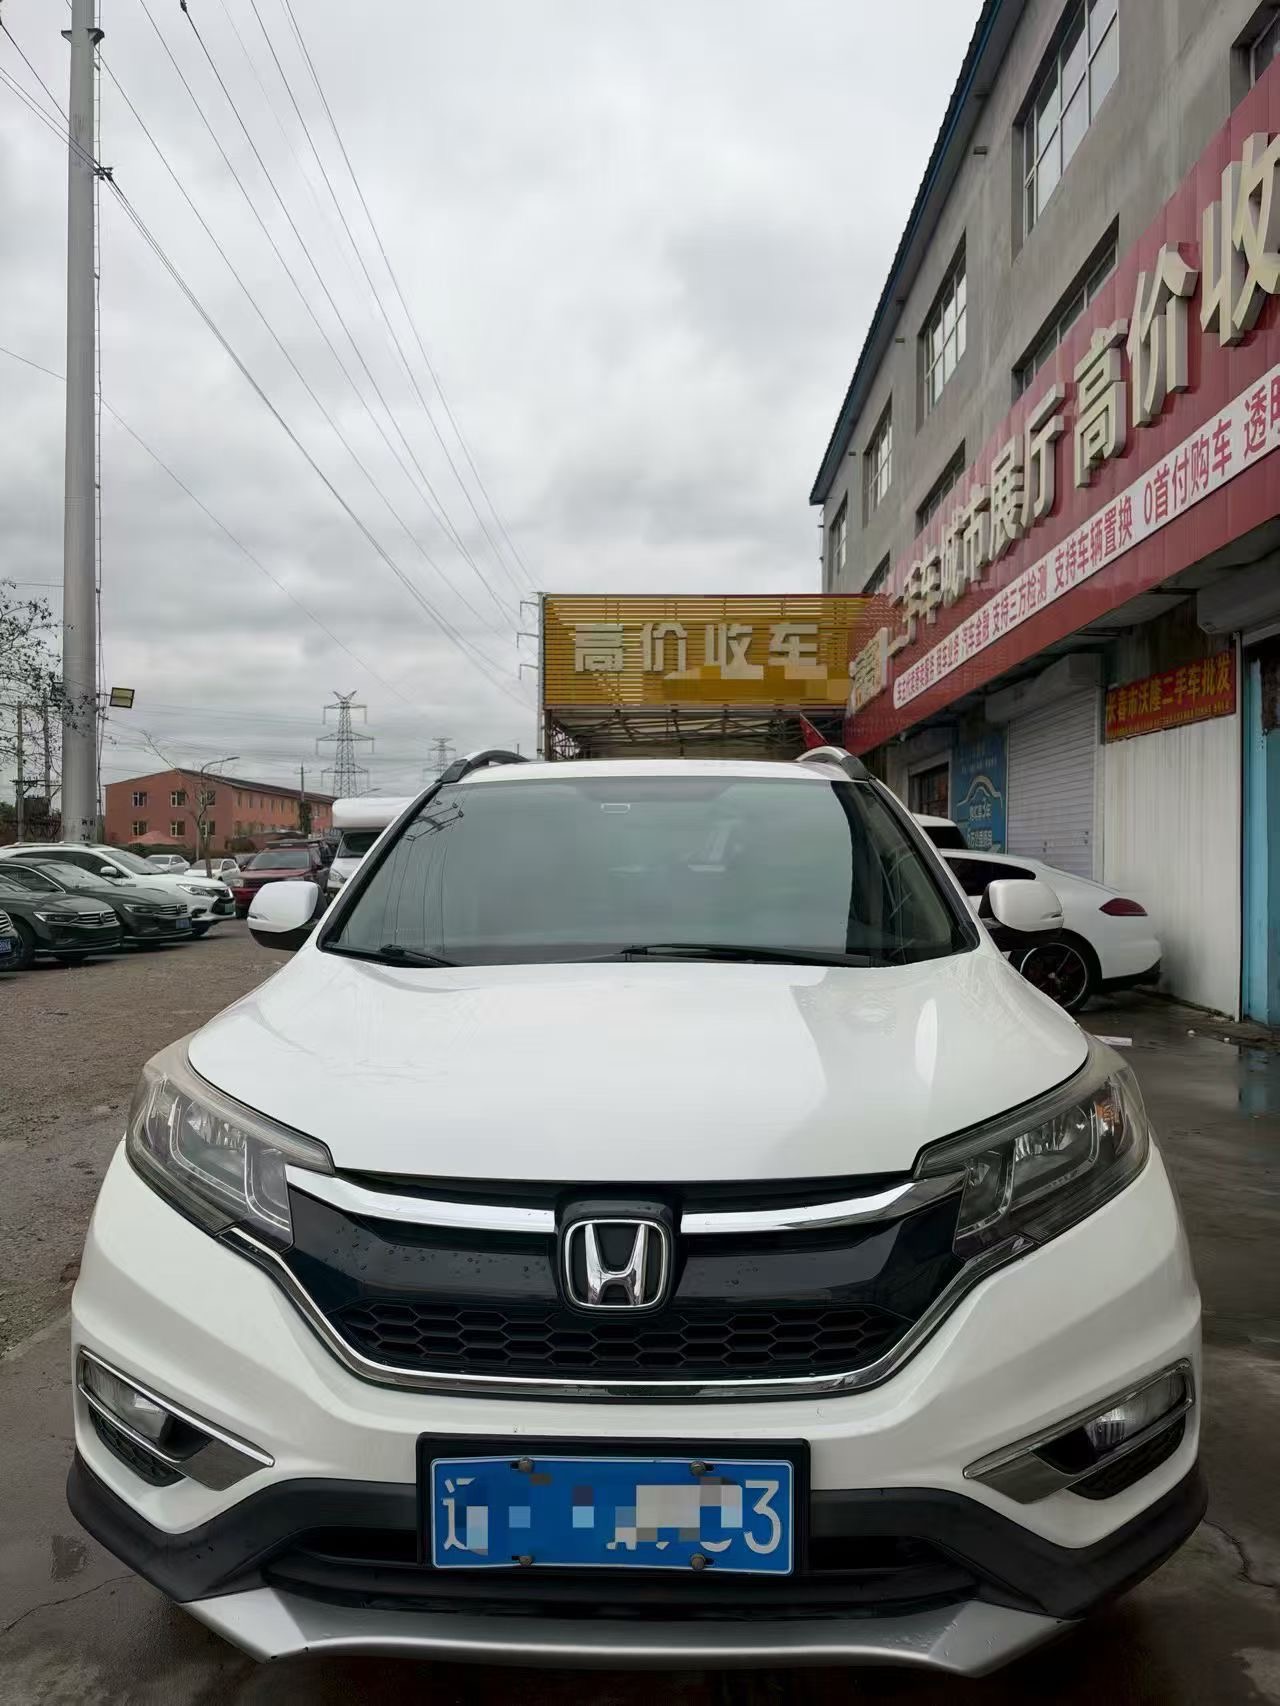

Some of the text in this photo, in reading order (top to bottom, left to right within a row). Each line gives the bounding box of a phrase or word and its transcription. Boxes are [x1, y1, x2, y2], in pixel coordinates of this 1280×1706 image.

[1054, 496, 1133, 593] 支持车辆置换
[1144, 419, 1232, 525] 0首付购车
